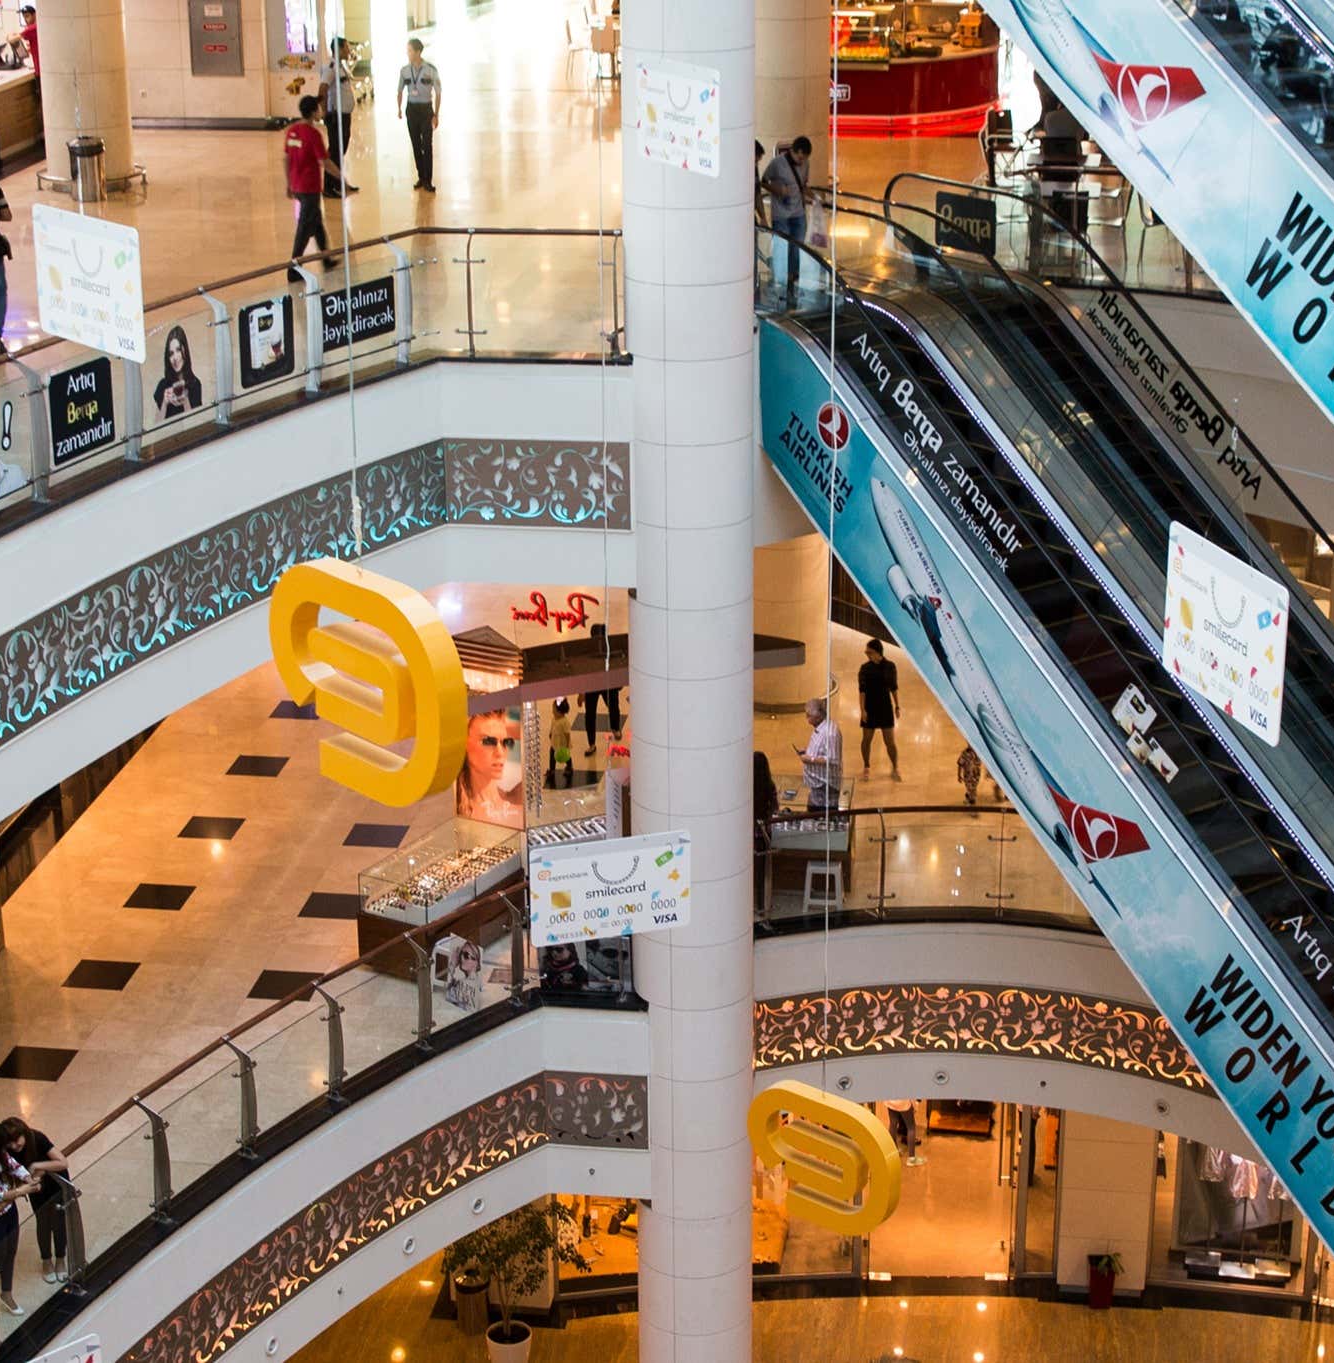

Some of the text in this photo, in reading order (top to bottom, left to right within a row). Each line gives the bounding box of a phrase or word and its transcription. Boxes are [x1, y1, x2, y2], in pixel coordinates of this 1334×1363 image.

[117, 336, 137, 351] VISA
[67, 372, 96, 396] Artıq
[67, 400, 98, 424] Berqa
[56, 417, 112, 457] zamanıdır
[852, 333, 1023, 553] Artıq Berqa zamanıdır
[788, 410, 854, 500] TURKISH
[779, 429, 847, 514] AIRLINES
[1250, 705, 1269, 730] VISA
[585, 881, 647, 900] smilecard
[650, 898, 677, 911] 0000
[653, 913, 679, 925] VISA
[1282, 915, 1333, 981] Artıq
[1210, 953, 1311, 1089] WIDEN
